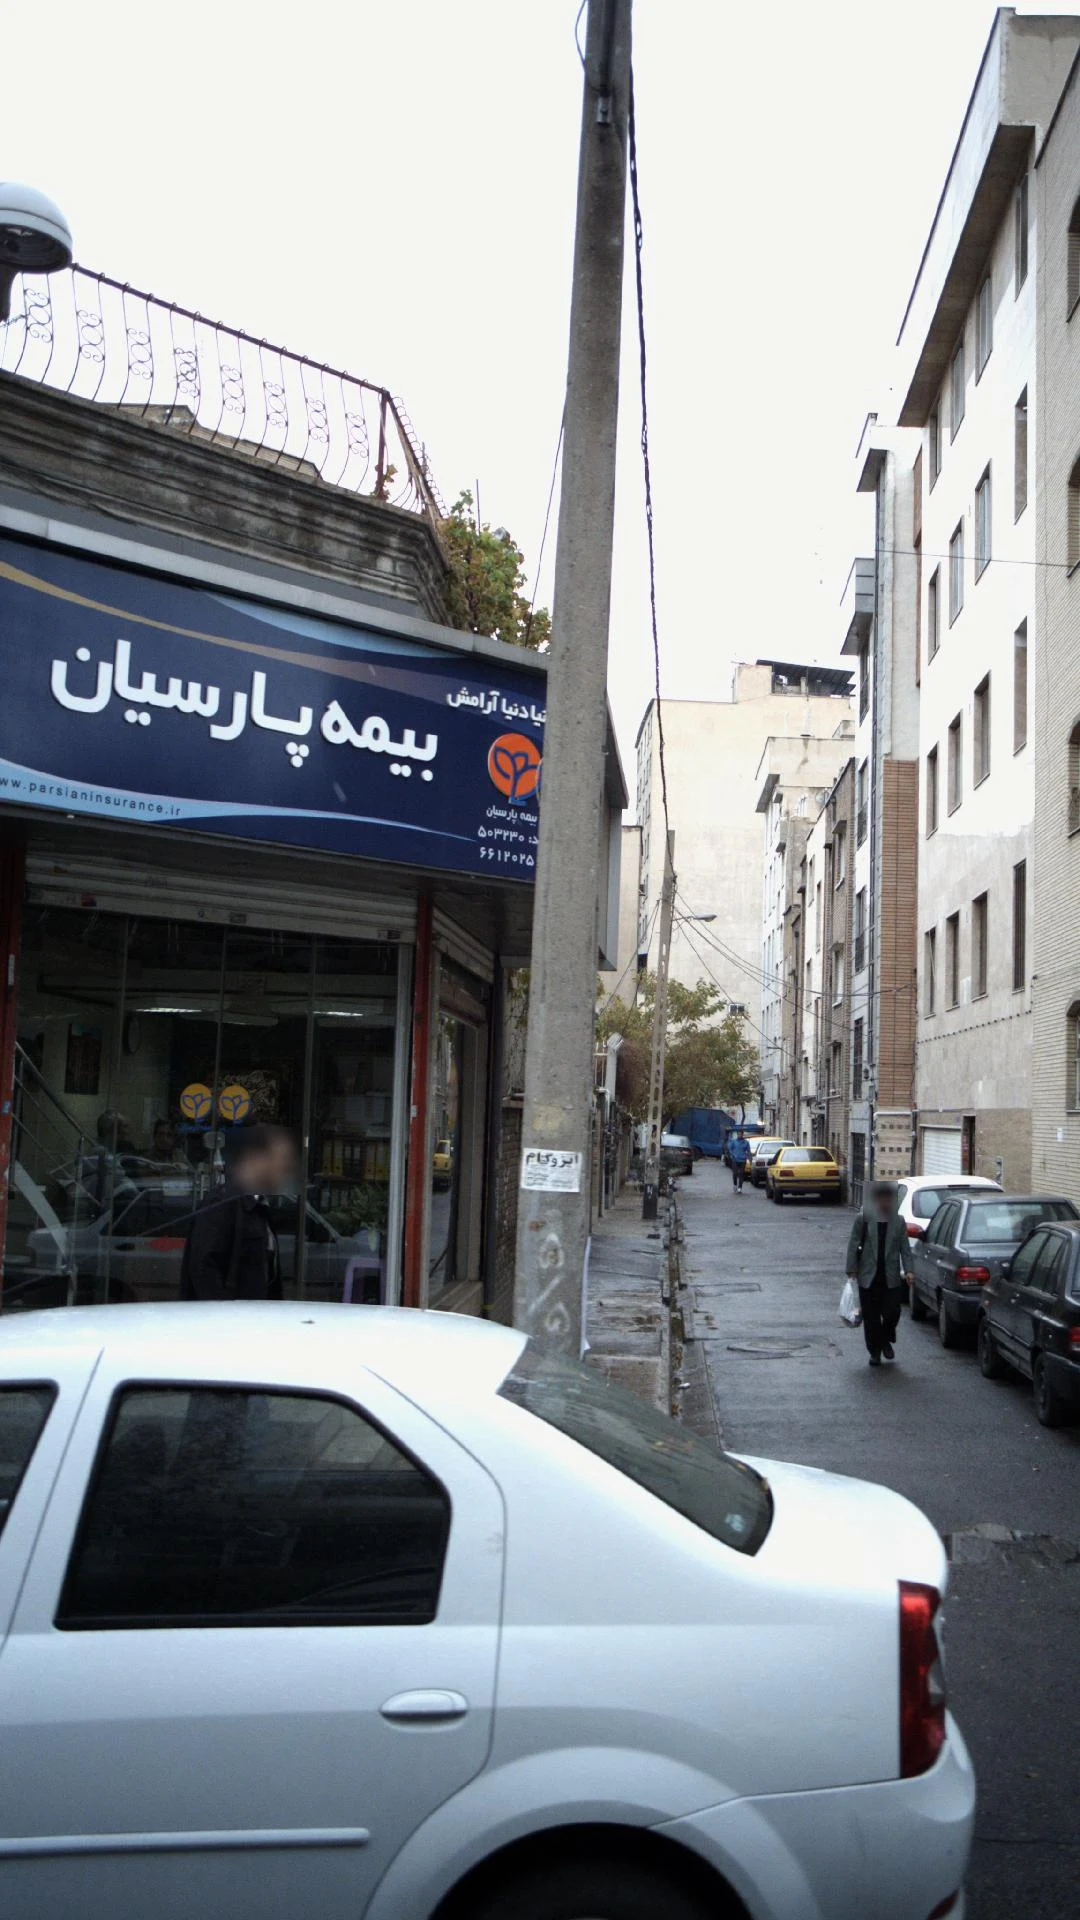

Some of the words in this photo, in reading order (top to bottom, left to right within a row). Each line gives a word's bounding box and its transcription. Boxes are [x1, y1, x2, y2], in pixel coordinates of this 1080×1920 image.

[51, 638, 313, 767] پارسیان
[446, 686, 500, 715] آرامش
[501, 697, 529, 720] دنیا
[320, 699, 438, 781] بیمه
[0, 777, 182, 816] ww.parsianinsurance.ir
[485, 804, 518, 825] پارسیان
[519, 811, 538, 827] بیمه
